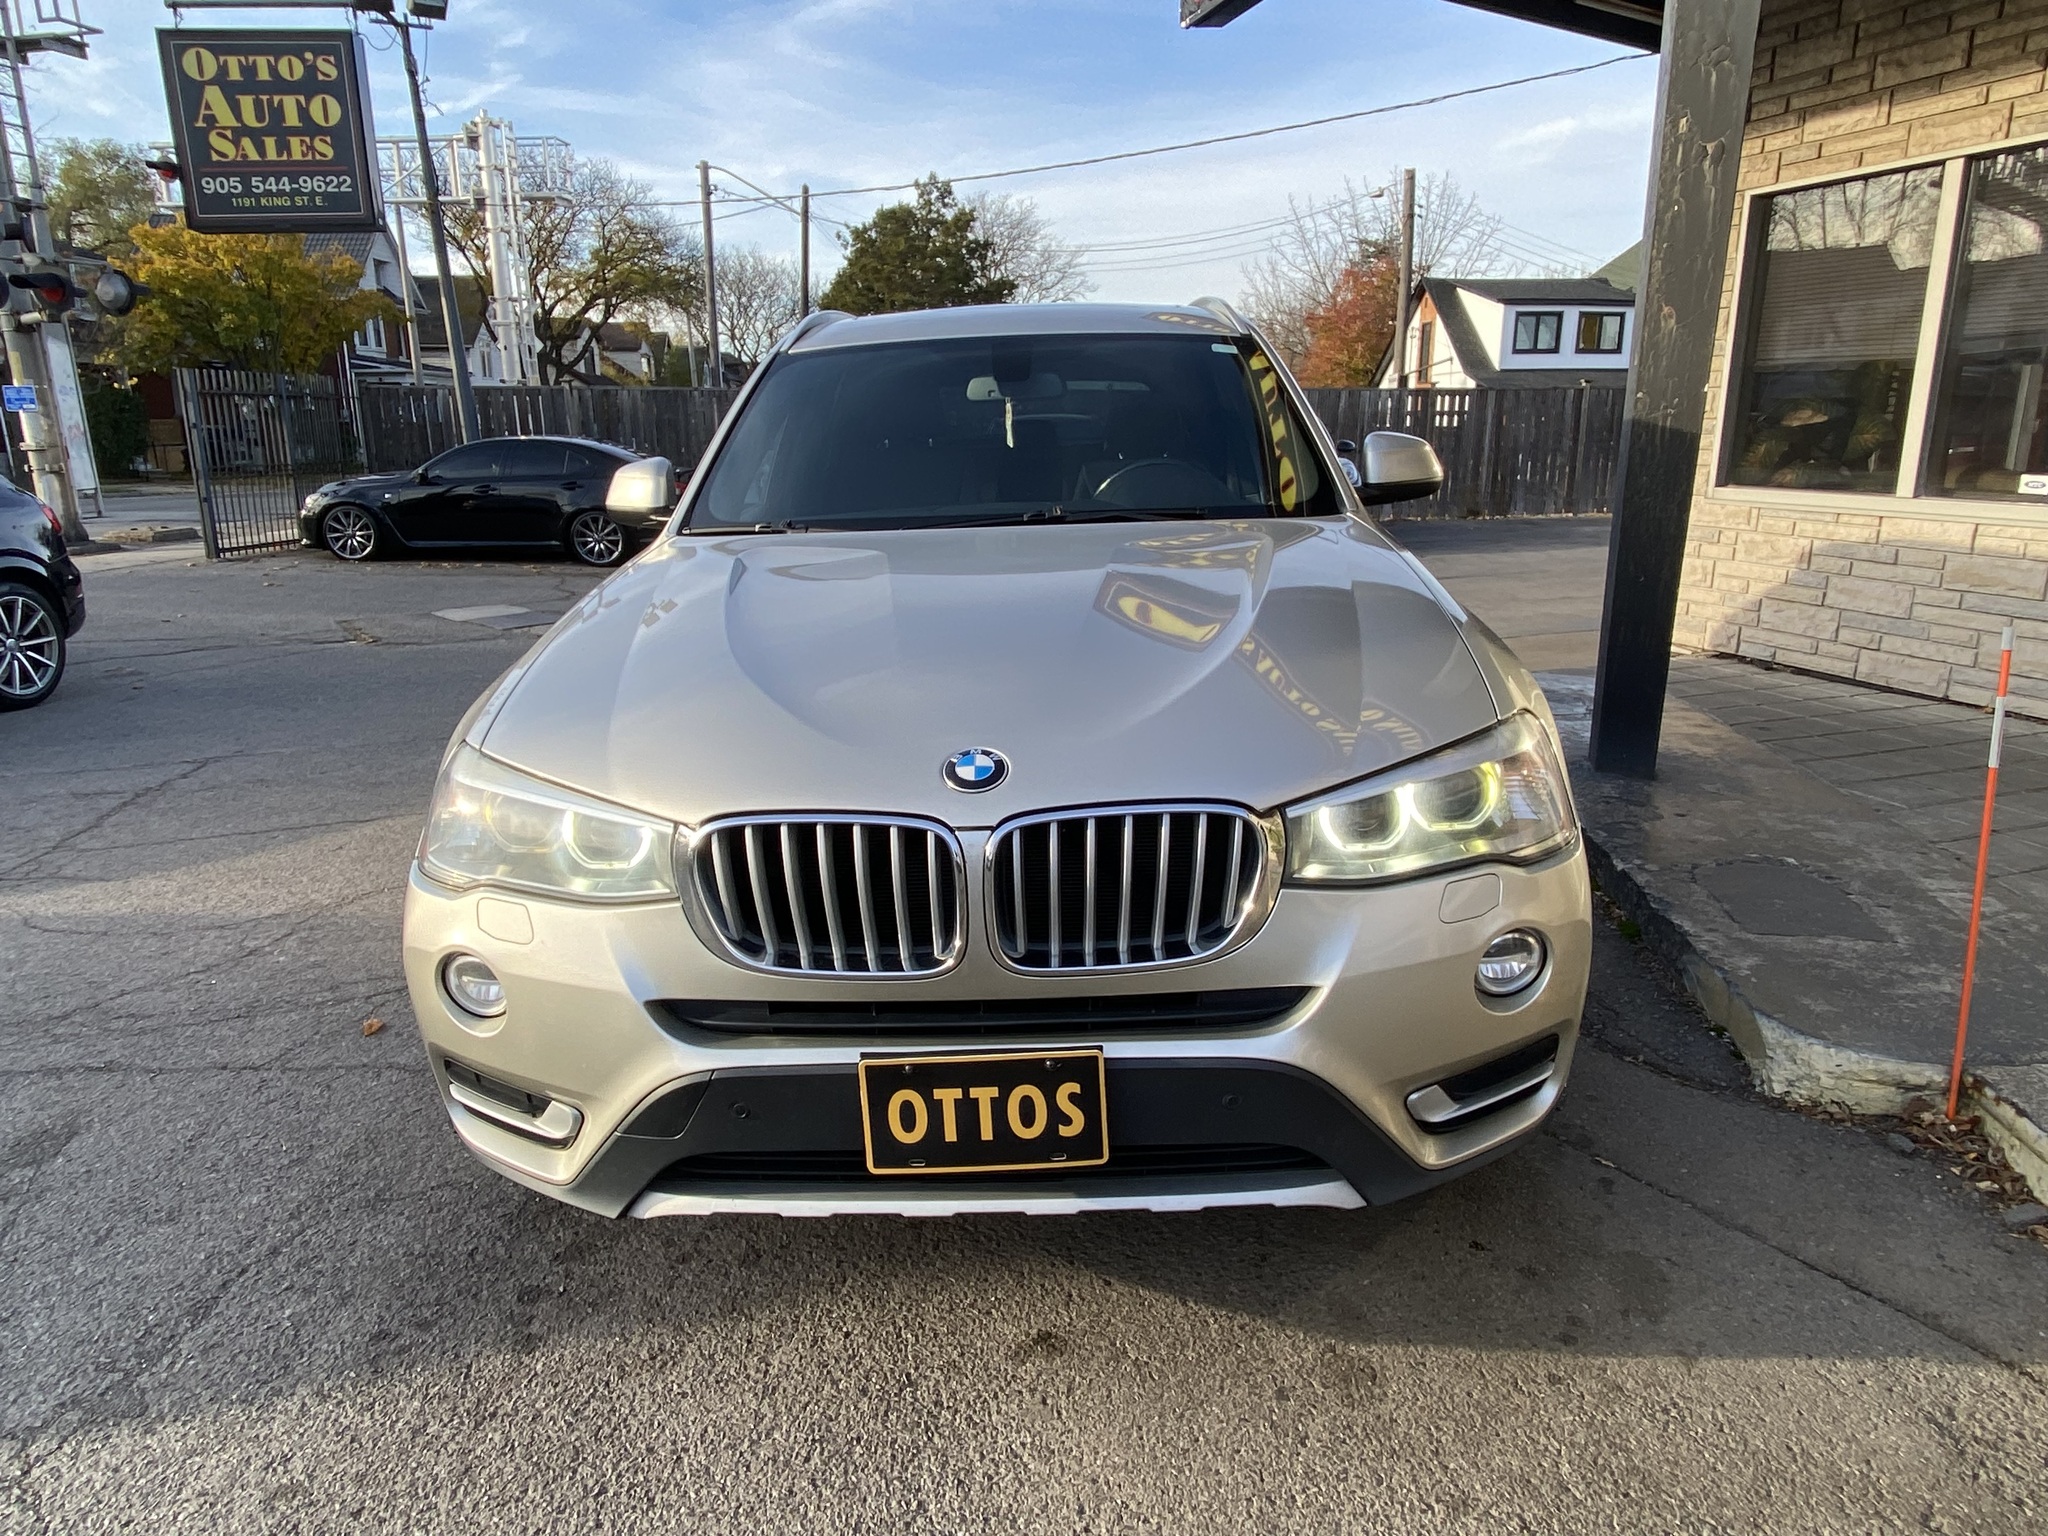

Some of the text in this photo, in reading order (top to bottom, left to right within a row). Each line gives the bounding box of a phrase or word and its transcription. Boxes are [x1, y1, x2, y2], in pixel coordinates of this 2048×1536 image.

[181, 47, 338, 81] OTTO'S
[194, 84, 342, 128] AUTO
[207, 129, 335, 162] SALES
[201, 175, 353, 194] 905 544-9622
[231, 197, 256, 207] 1191
[260, 196, 291, 206] KING
[887, 1081, 1086, 1144] OTTOS
